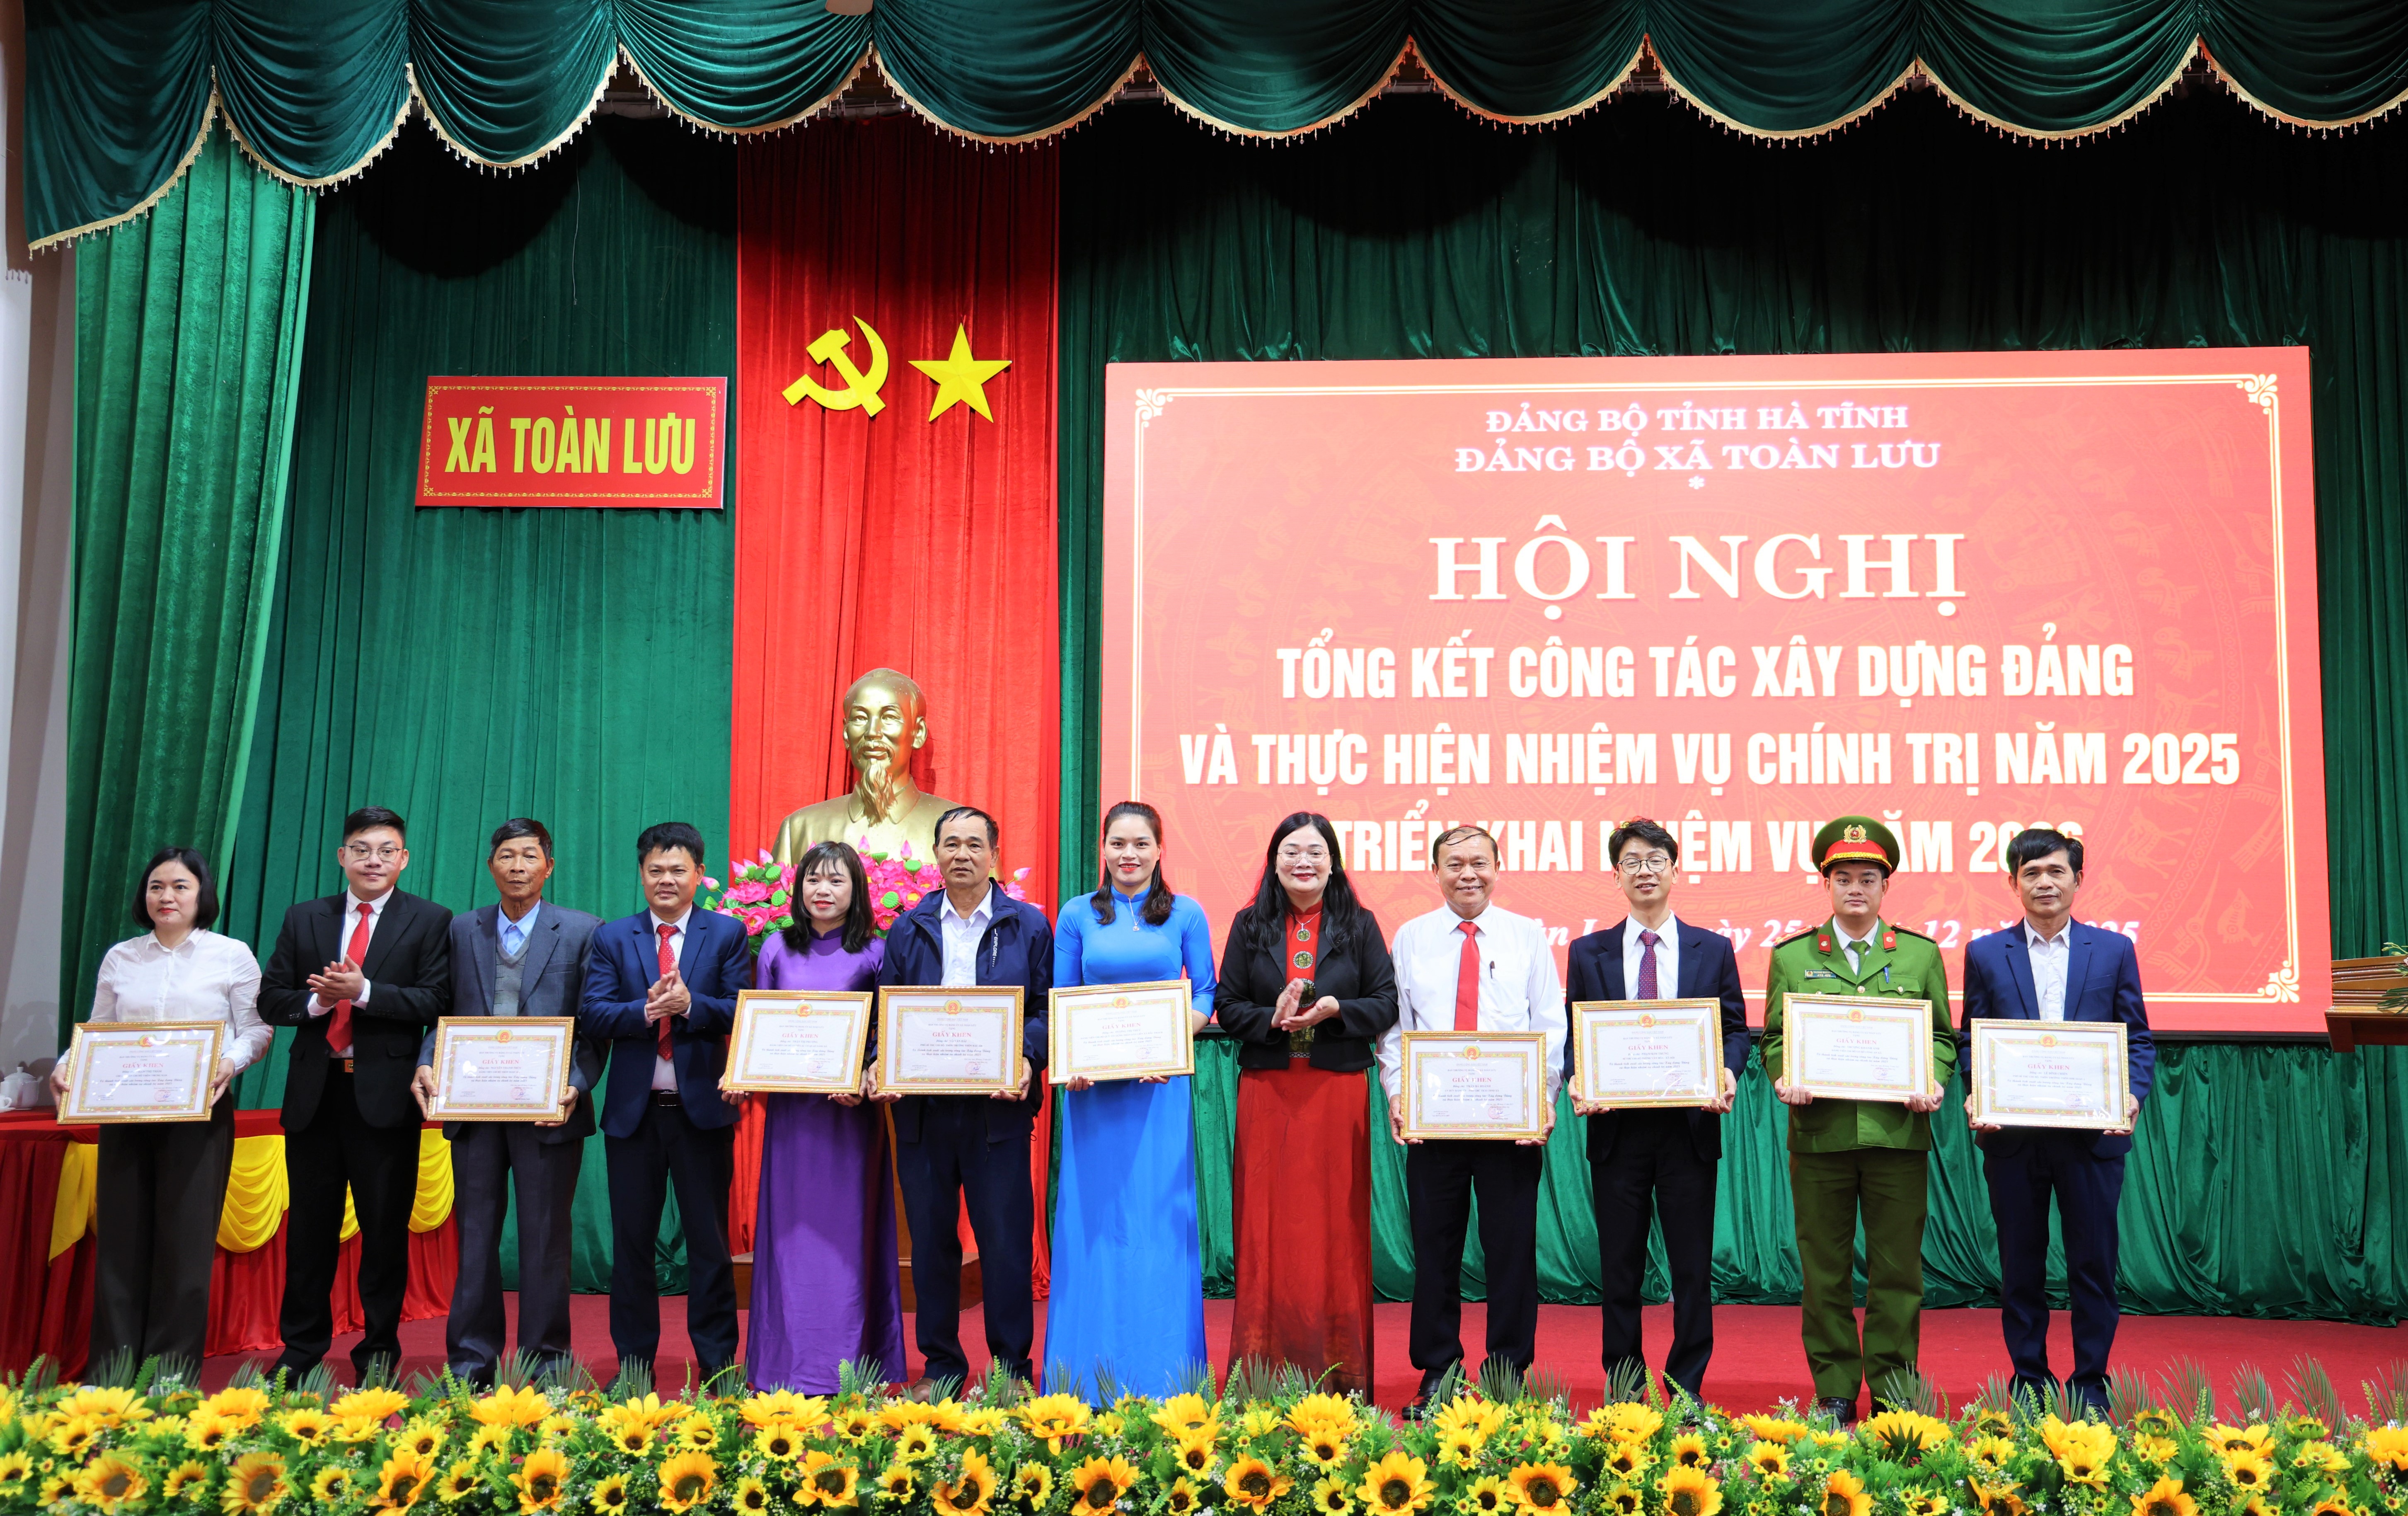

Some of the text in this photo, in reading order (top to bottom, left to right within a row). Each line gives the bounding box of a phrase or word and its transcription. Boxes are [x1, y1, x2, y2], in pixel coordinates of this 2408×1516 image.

[445, 405, 696, 474] XÃ TOÀN LƯU
[1486, 401, 1908, 436] ĐẢNG BỘ TỈNH HÀ TĨNH
[1455, 437, 1940, 477] ĐẢNG BỘ XÃ TOÀN LƯU
[1429, 515, 1965, 620] HỘI NGHỊ
[1277, 623, 2132, 707] TỔNG KẾT CÔNG TÁC XÂY DỰNG ĐẢNG
[1180, 722, 2239, 795] VÀ THỰC HIỆN NHIỆM VỤ CHÍNH TRỊ NĂM 2025
[1767, 821, 1826, 883] VỤ
[1883, 810, 1953, 872] ĂM
[1924, 920, 1960, 948] 12
